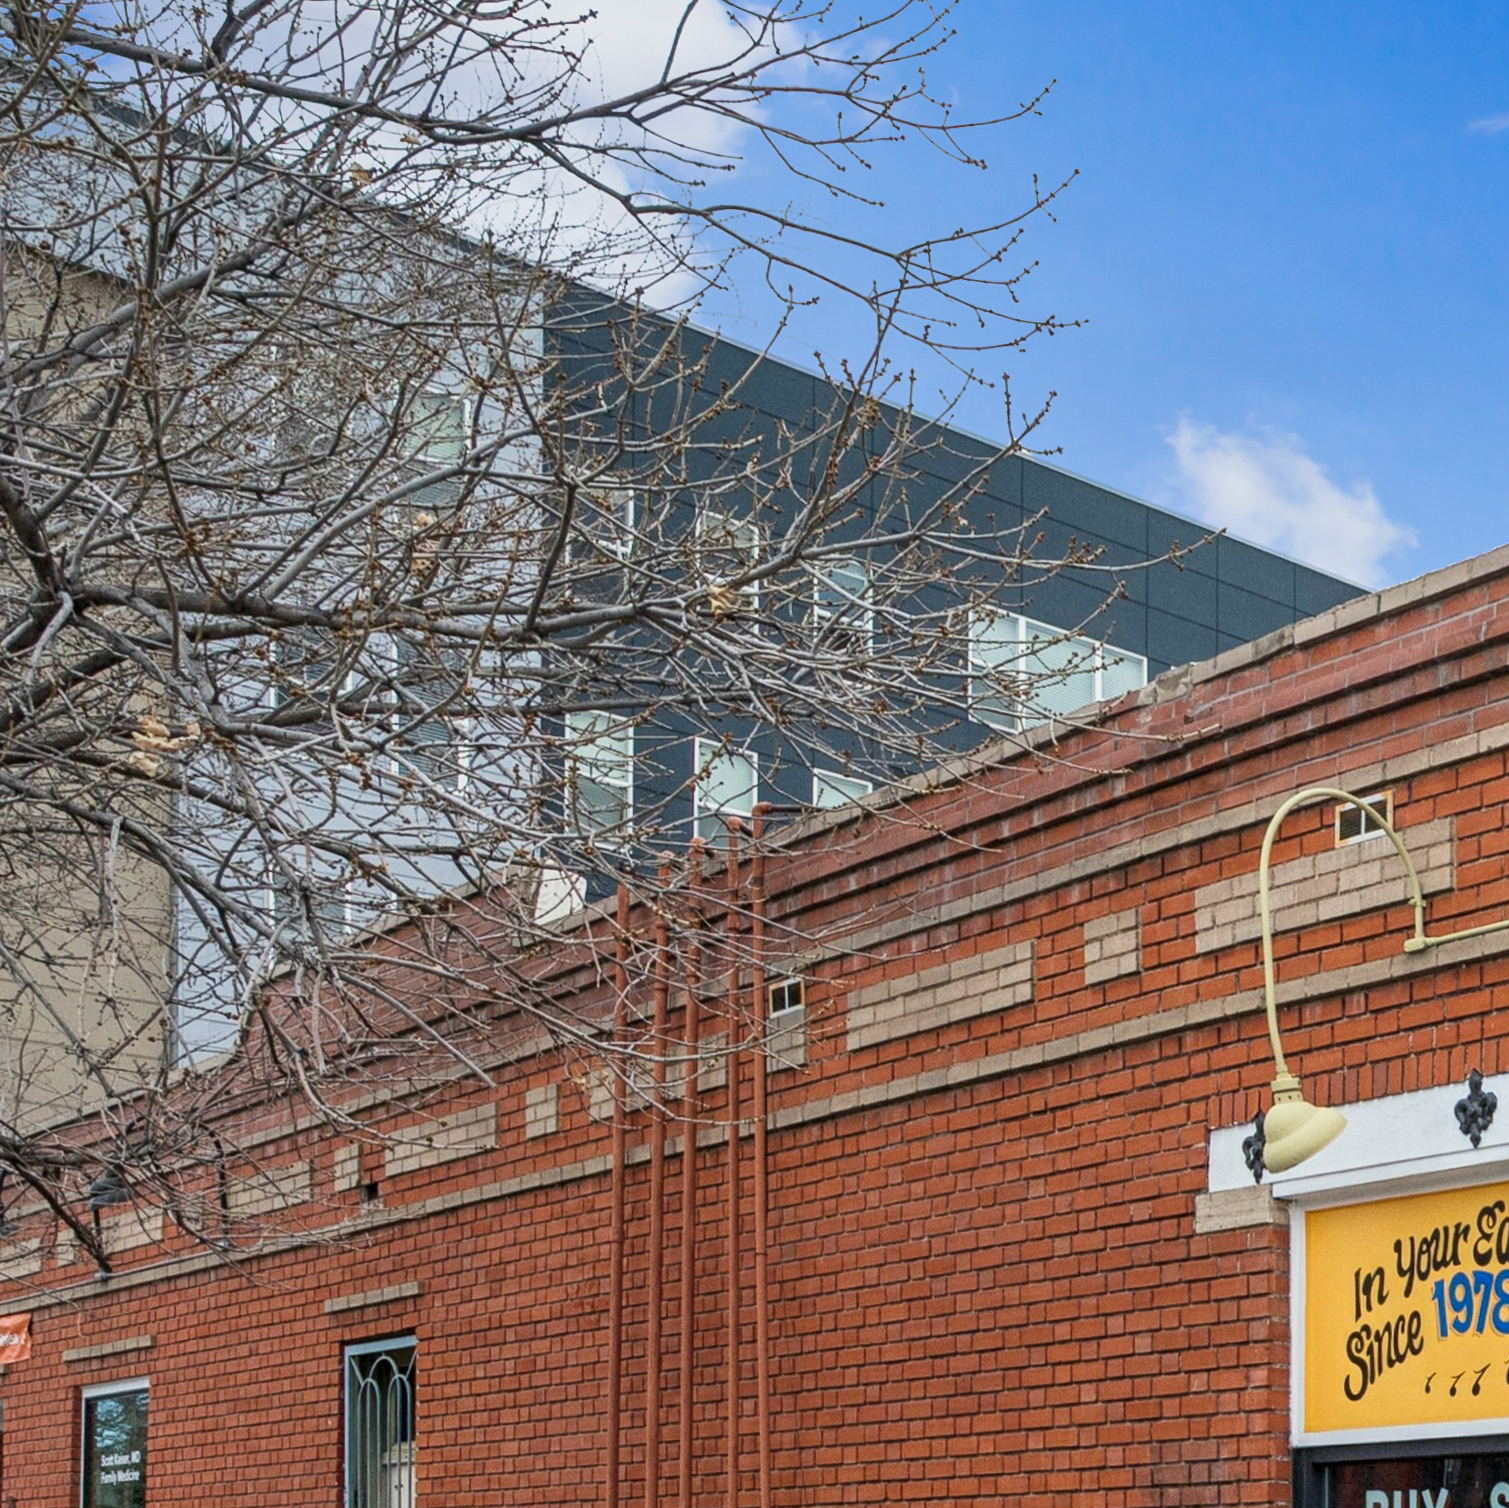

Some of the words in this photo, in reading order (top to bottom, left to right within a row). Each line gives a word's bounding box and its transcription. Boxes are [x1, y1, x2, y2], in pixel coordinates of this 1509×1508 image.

[1354, 1264, 1389, 1324] In
[1344, 1310, 1425, 1402] Since
[118, 1469, 140, 1482] Medicine
